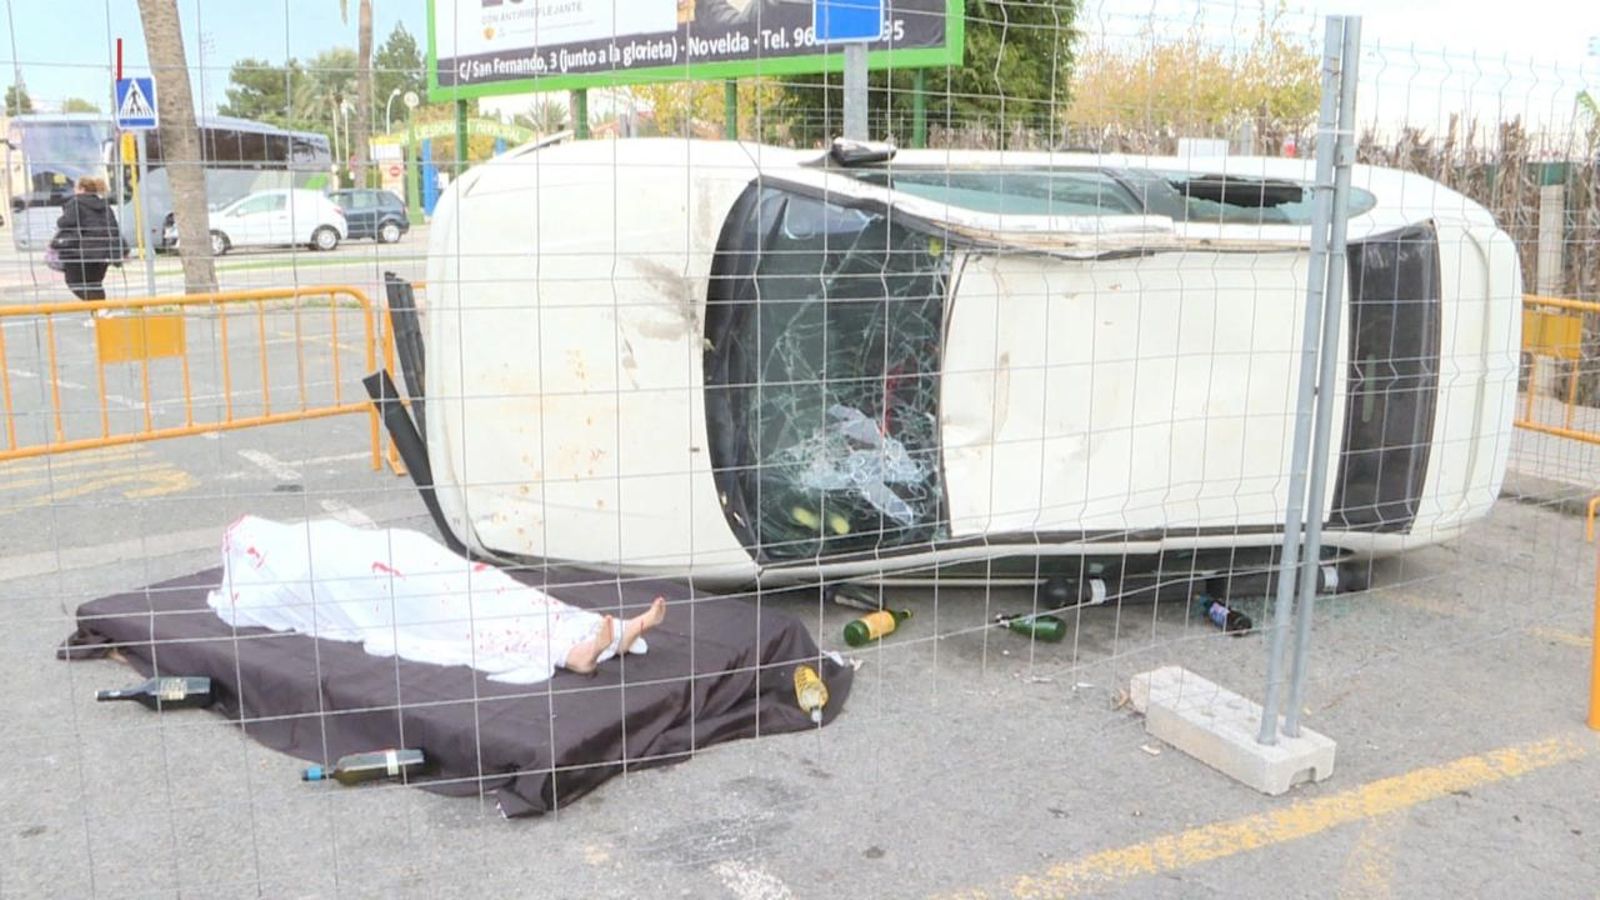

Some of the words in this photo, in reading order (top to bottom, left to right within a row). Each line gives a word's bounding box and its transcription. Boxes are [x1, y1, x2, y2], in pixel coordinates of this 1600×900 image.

[459, 59, 470, 81] C/
[473, 59, 492, 78] San
[494, 53, 548, 75] Fernando,
[550, 52, 557, 69] 3
[559, 48, 597, 73] (junto
[599, 50, 606, 63] a
[609, 44, 621, 62] la
[623, 36, 677, 67] glorieta)
[689, 32, 749, 56] Novelda
[762, 27, 789, 50] Tel.
